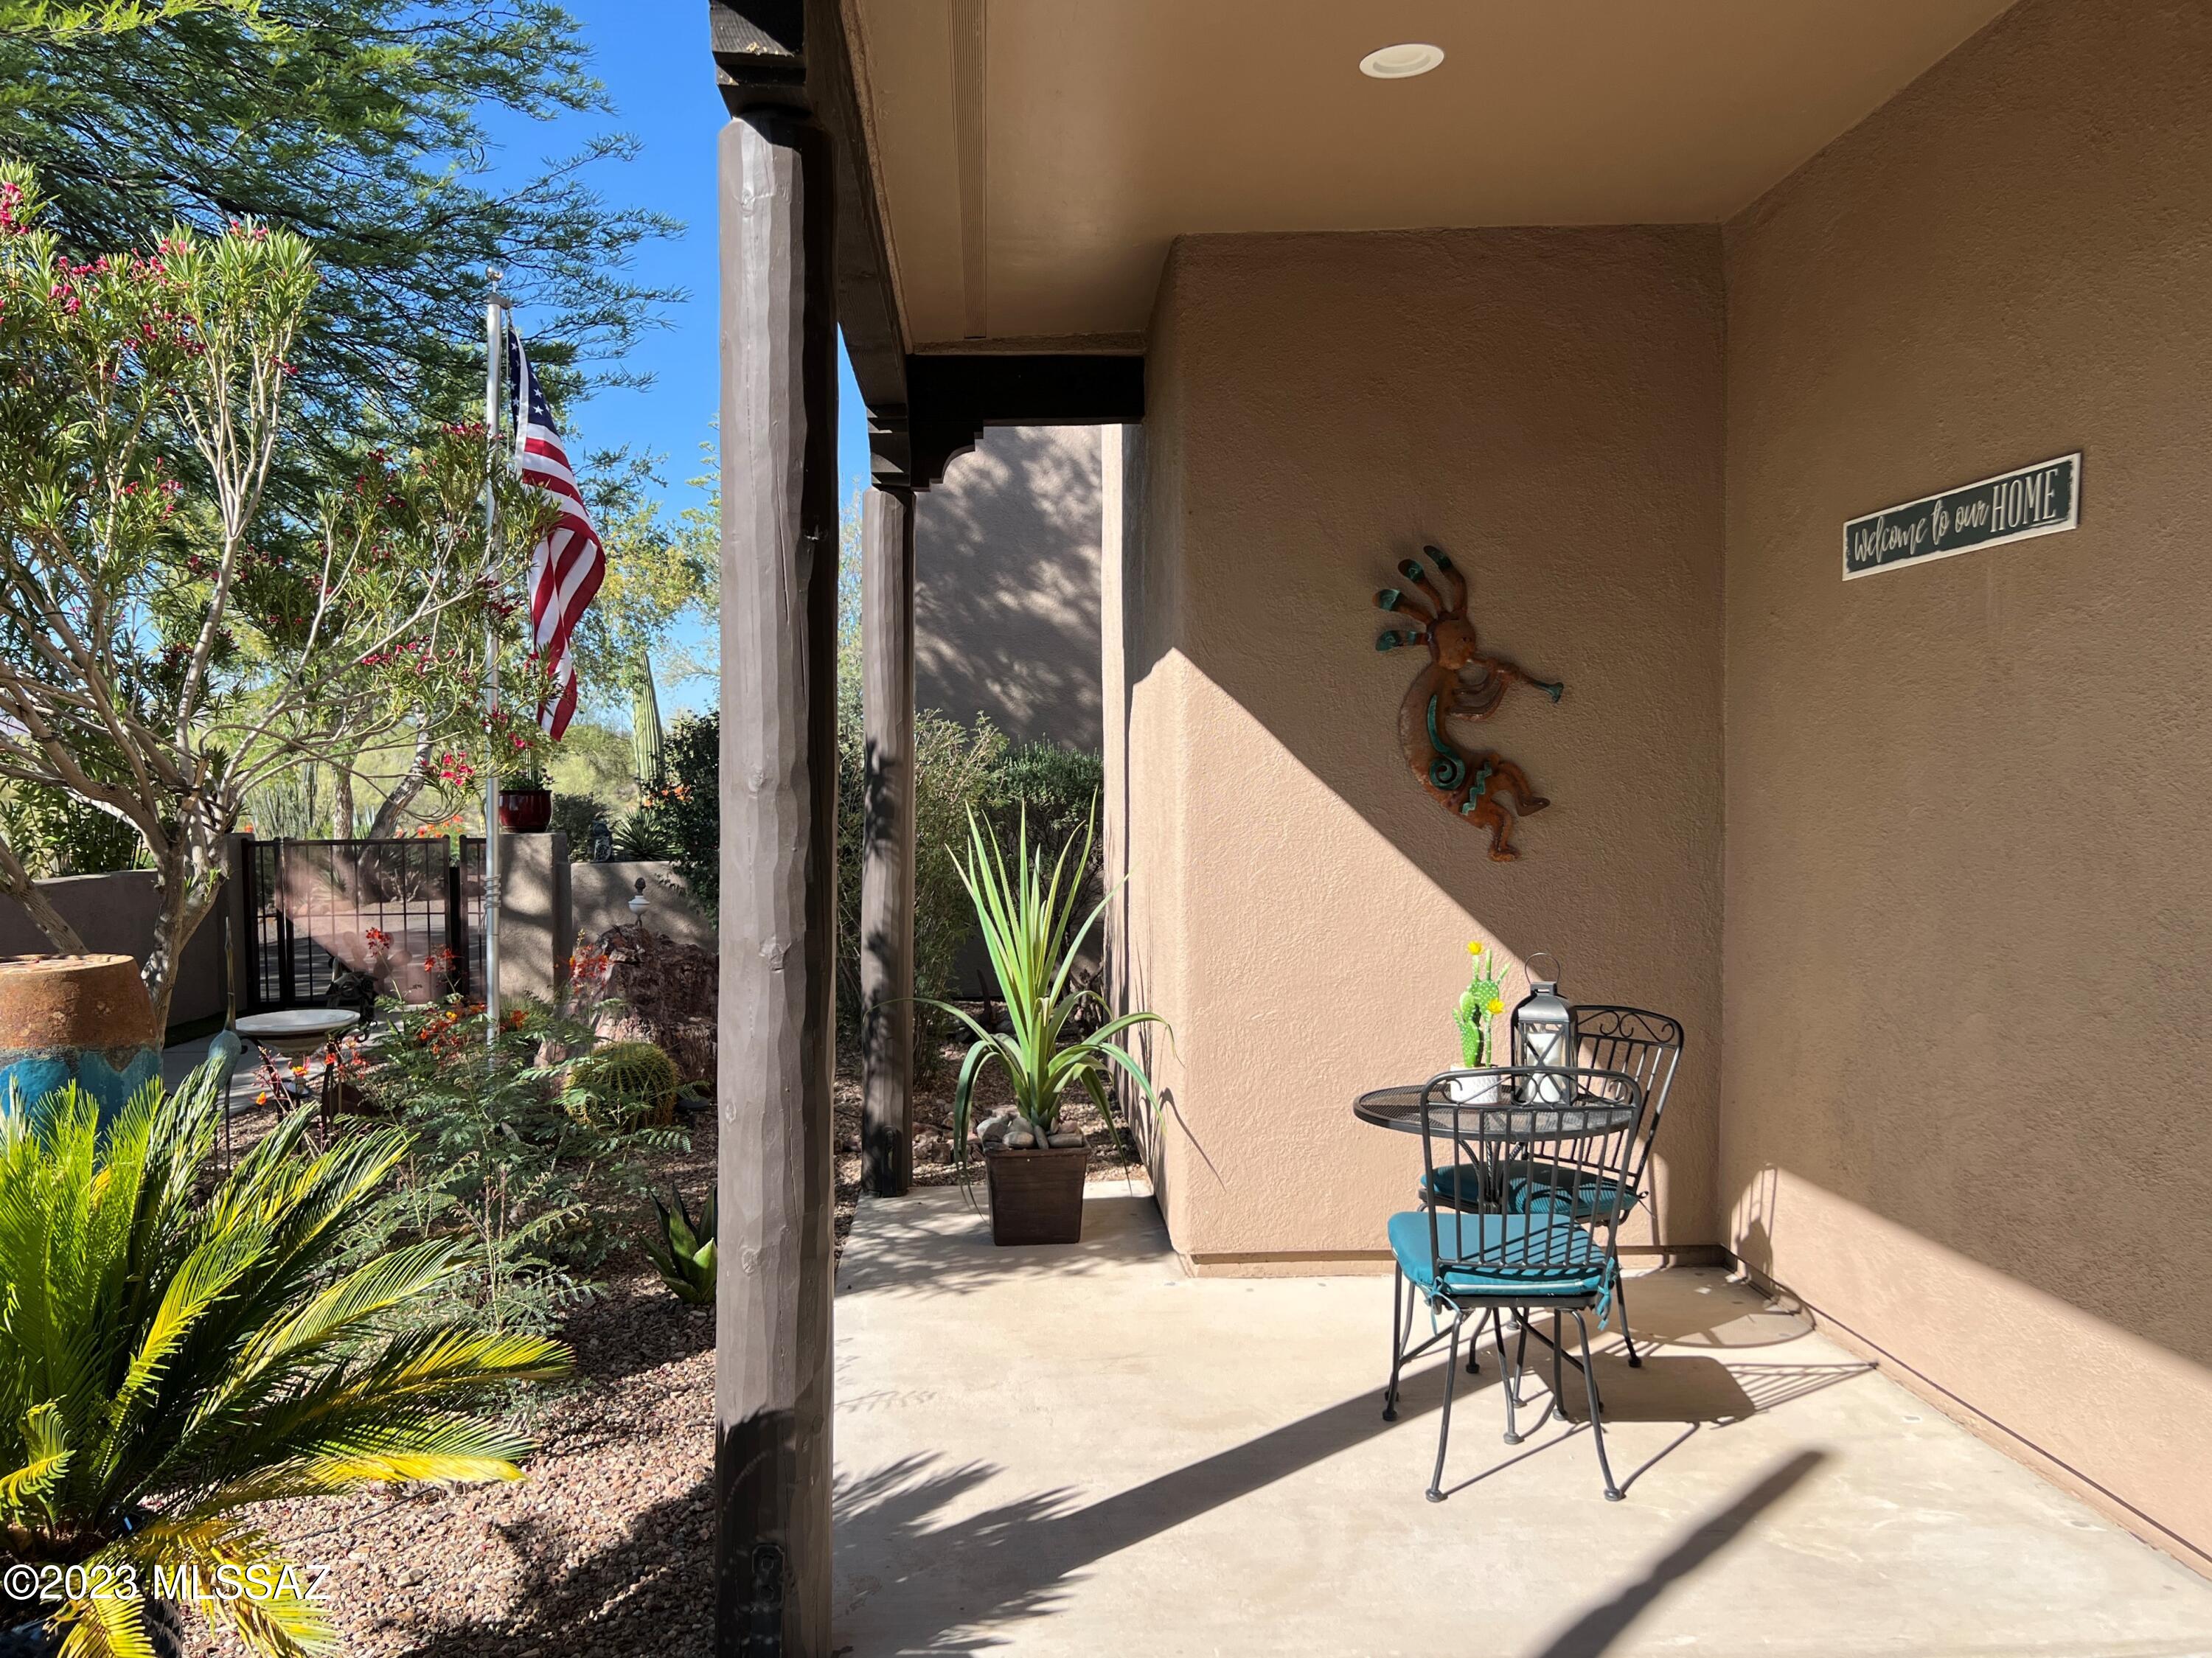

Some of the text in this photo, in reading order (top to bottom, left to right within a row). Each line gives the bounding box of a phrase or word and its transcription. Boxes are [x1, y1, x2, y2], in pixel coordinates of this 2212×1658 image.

[1931, 499, 1950, 545] to
[1955, 499, 1990, 533] our
[1990, 467, 2059, 533] HOME
